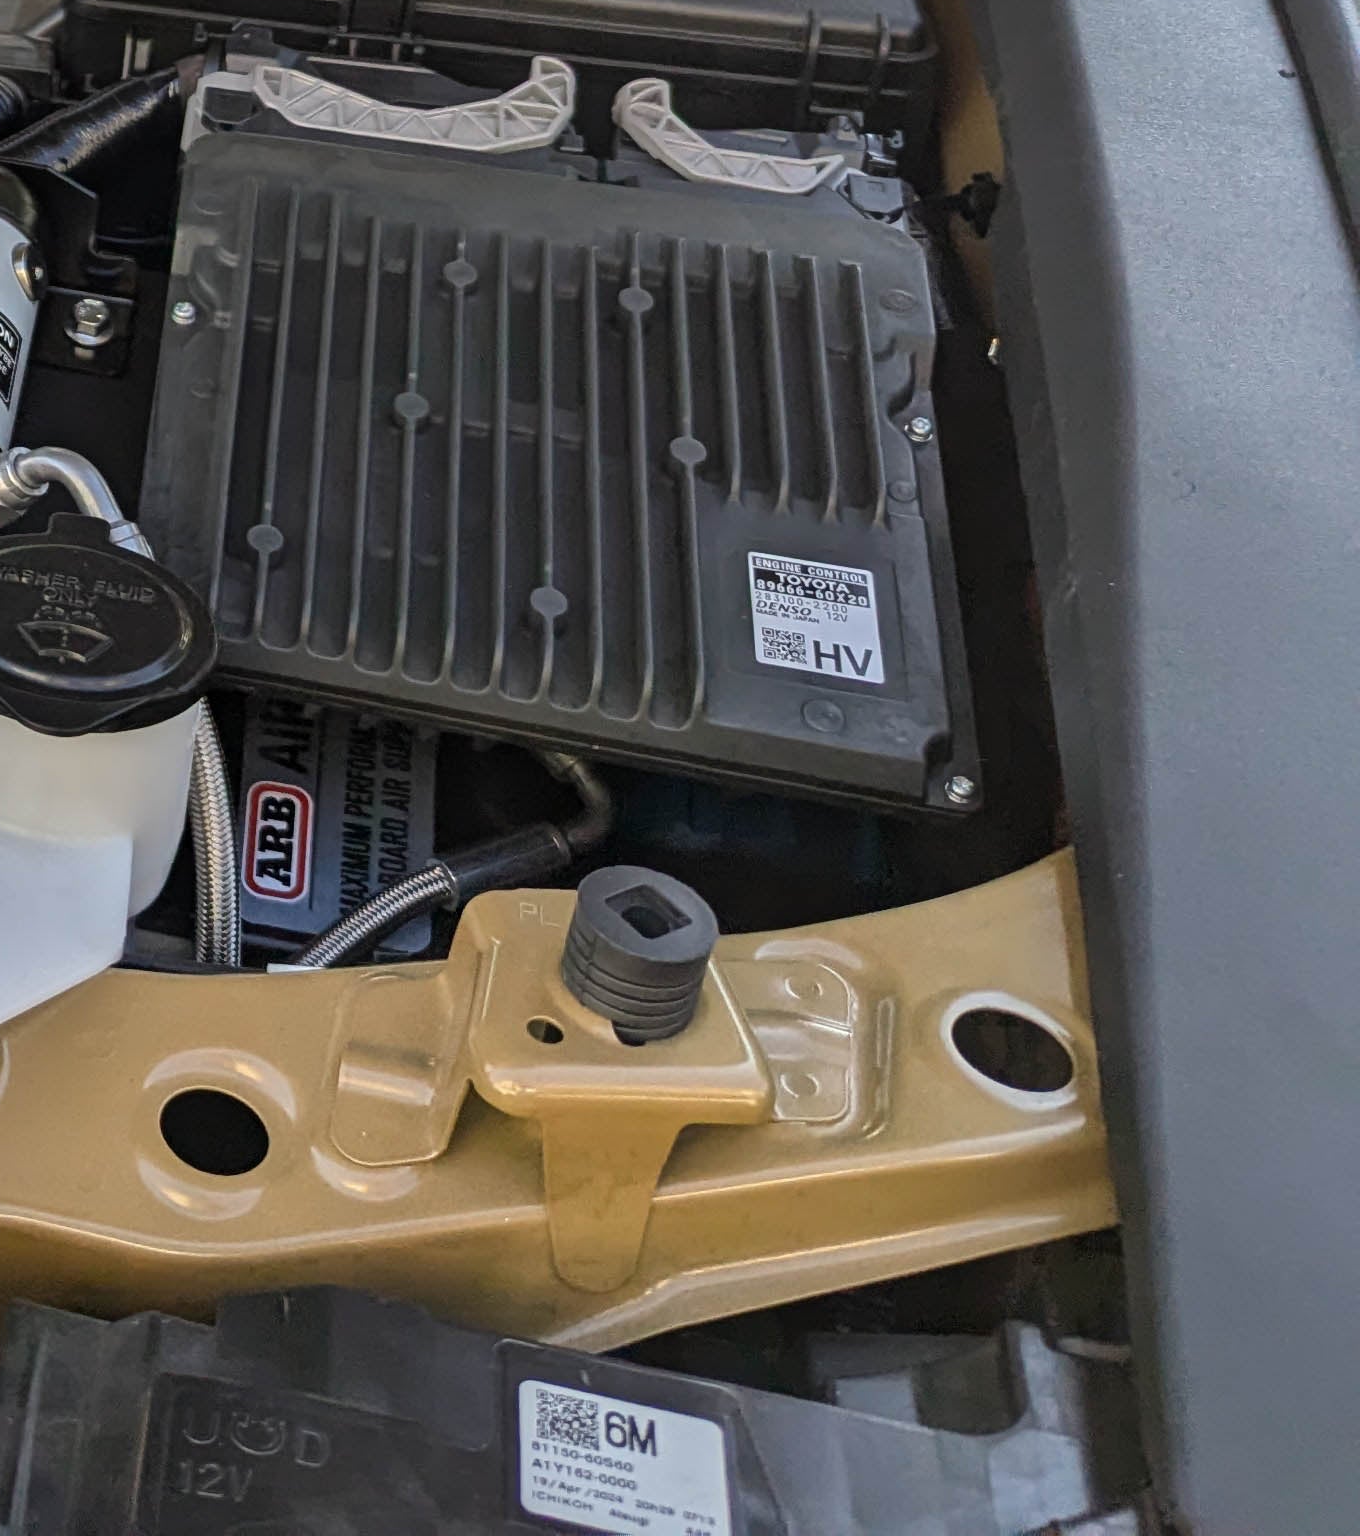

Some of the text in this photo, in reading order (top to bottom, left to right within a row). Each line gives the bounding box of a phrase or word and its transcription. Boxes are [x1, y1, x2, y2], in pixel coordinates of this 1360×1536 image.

[755, 557, 865, 584] ENGINE CONTROL
[775, 572, 850, 594] TOYOTA
[42, 587, 98, 608] ONLY
[755, 591, 848, 614] 283100-2200
[756, 578, 868, 606] 89666-60X20
[755, 608, 778, 617] MADE
[756, 600, 812, 616] DENSO
[827, 611, 848, 622] 12V
[813, 640, 872, 676] HV
[382, 777, 412, 813] AIR
[255, 795, 298, 888] ARB
[604, 1410, 658, 1457] 6M
